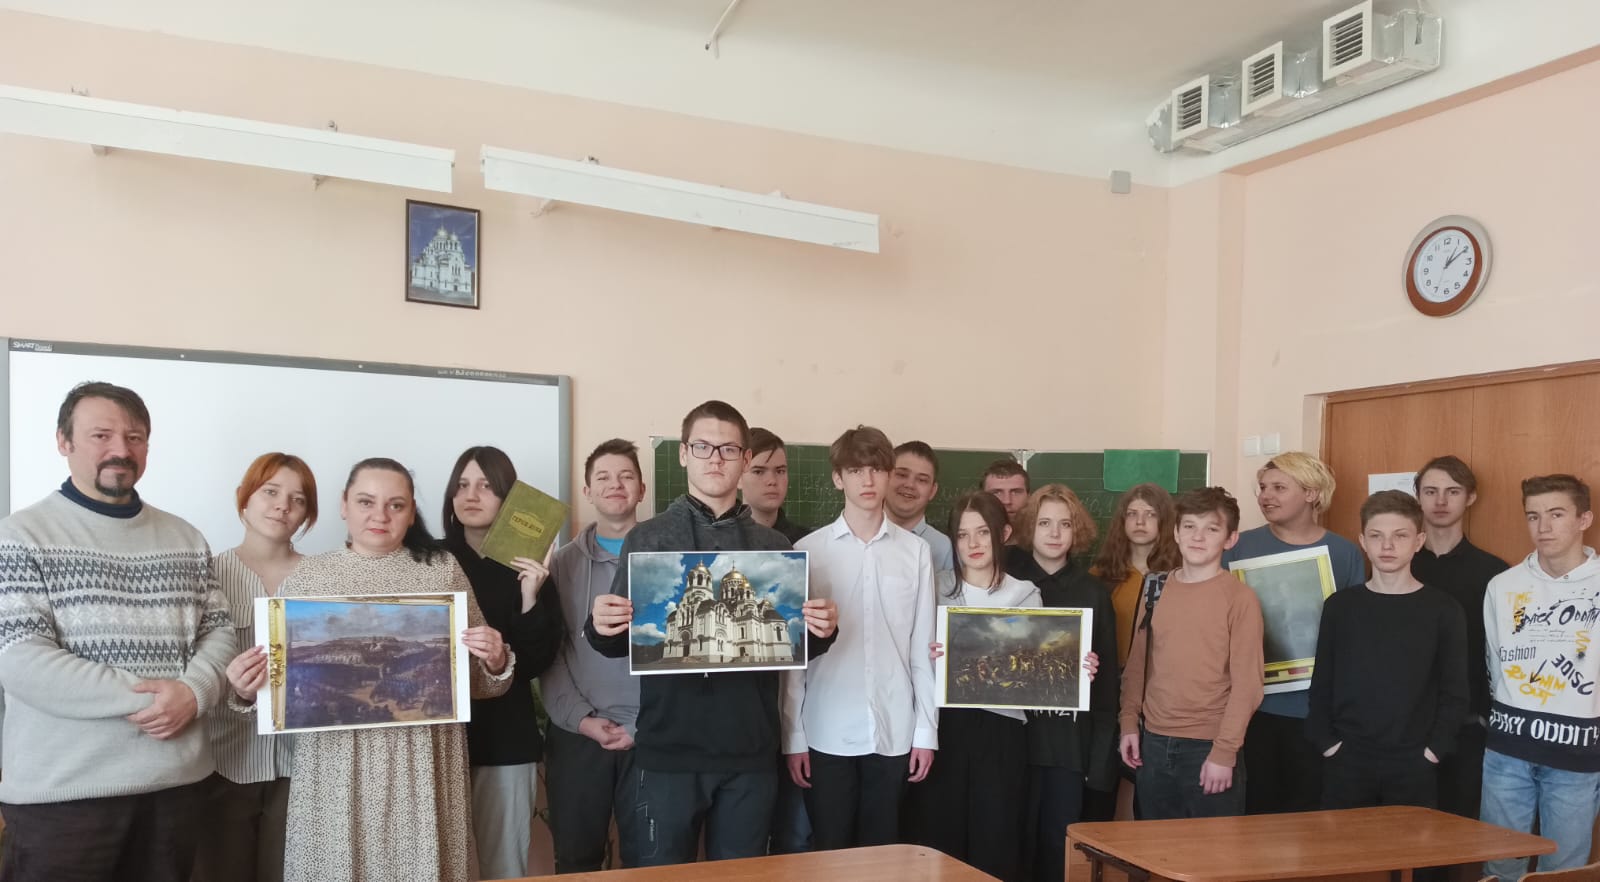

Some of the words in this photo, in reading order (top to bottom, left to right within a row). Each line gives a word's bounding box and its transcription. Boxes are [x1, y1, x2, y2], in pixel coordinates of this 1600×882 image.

[1444, 237, 1452, 246] 12
[1434, 243, 1440, 251] 11
[1463, 245, 1469, 253] 2
[1465, 257, 1472, 266] 3
[1423, 267, 1429, 275] 9
[1426, 279, 1431, 287] 8
[1433, 286, 1439, 294] 7
[1499, 645, 1537, 663] fashion
